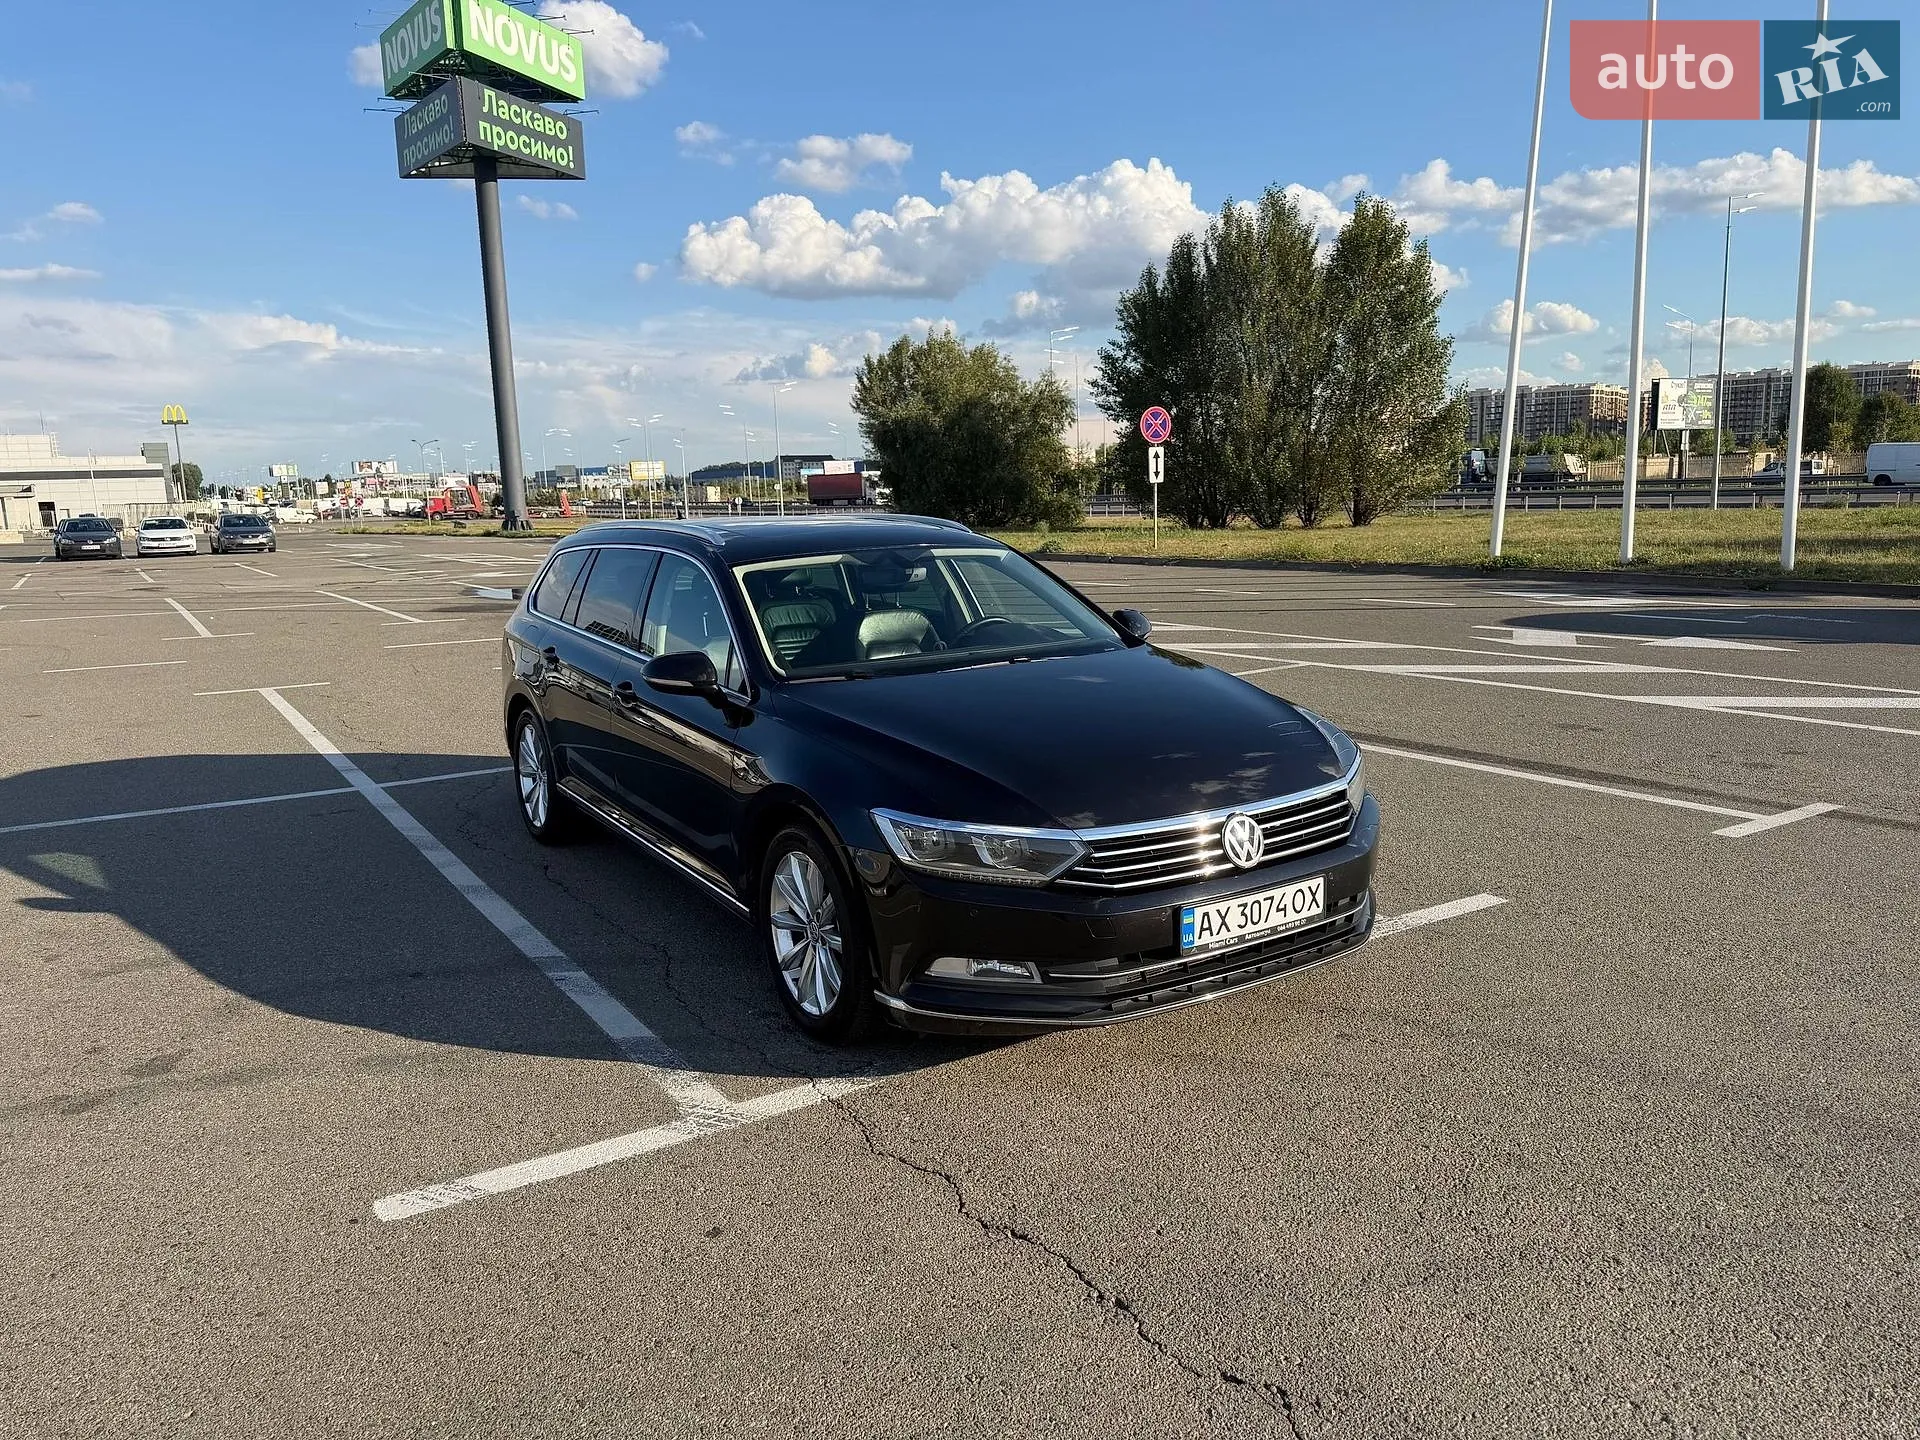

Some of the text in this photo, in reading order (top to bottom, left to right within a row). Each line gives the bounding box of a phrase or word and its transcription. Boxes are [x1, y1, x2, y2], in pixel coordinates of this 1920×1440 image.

[385, 0, 442, 79] NOVUS
[468, 0, 577, 83] NOVUS
[404, 94, 448, 139] Ласкаво
[482, 88, 568, 140] Ласкаво
[403, 116, 454, 168] просимо!
[479, 120, 575, 169] просимо!
[1198, 883, 1322, 940] AX 3074 OX
[1183, 933, 1194, 943] UA
